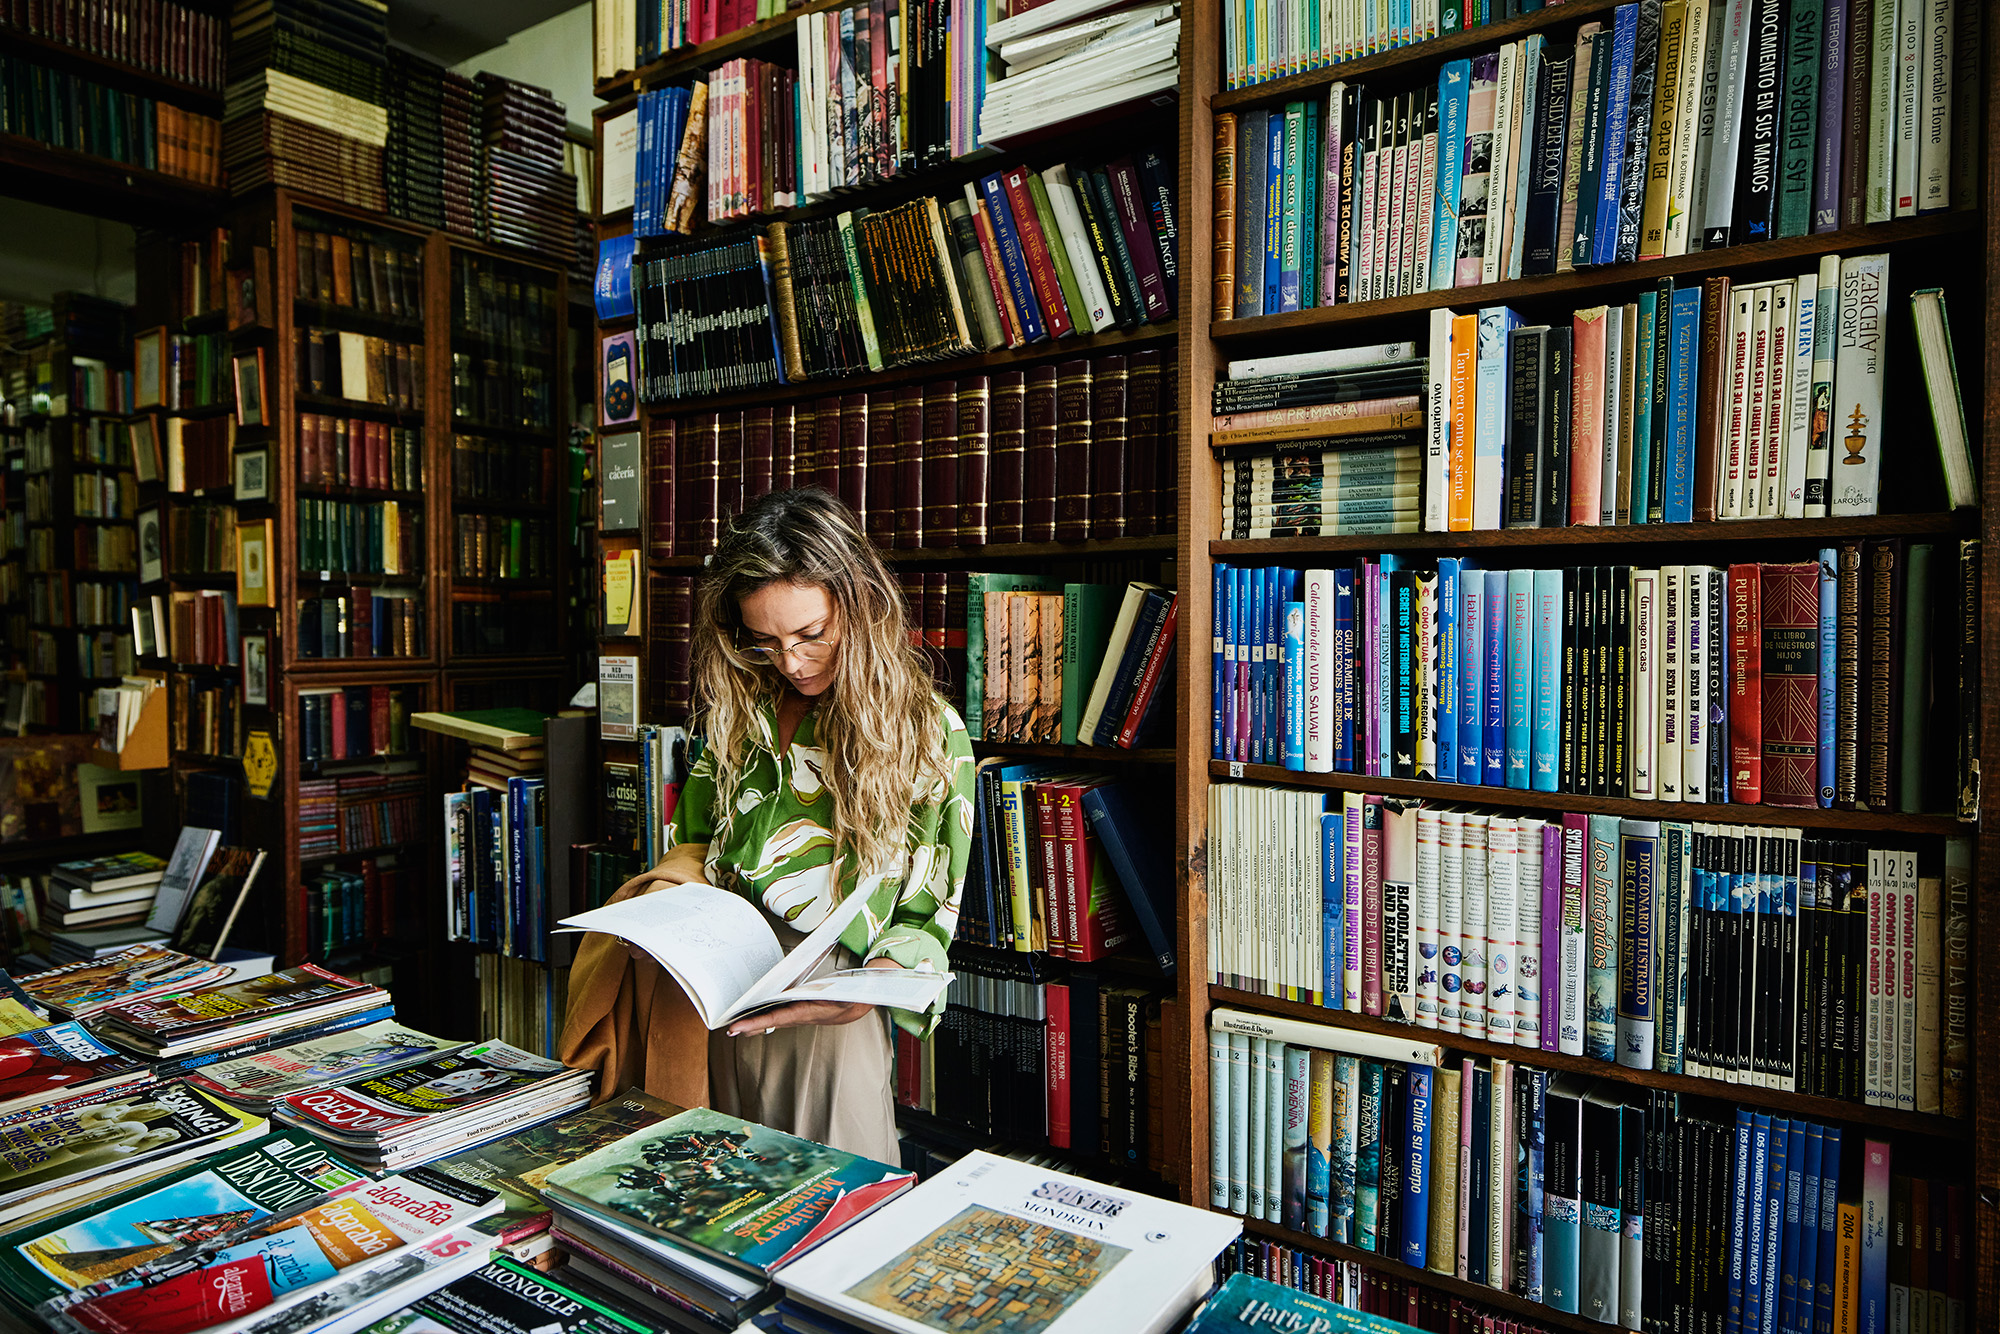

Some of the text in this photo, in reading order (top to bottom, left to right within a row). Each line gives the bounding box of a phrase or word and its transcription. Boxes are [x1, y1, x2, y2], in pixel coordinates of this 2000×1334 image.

[1905, 19, 1916, 49] color
[1931, 26, 1948, 102] Comfortable
[1428, 102, 1438, 118] 5
[1653, 19, 1681, 181] El arte vietnamita
[1757, 92, 1773, 111] EN
[1786, 10, 1816, 193] LAS PIEDRAS VIVAS
[1902, 65, 1915, 140] minimalismo
[1368, 125, 1373, 139] 1
[1384, 120, 1392, 135] 2
[1398, 118, 1407, 134] 3
[1413, 112, 1422, 128] 4
[1543, 60, 1569, 189] THE SILVER BOOK
[1756, 114, 1772, 139] SUS
[1931, 106, 1945, 144] Home
[1287, 110, 1300, 170] Jóvenes,
[1627, 116, 1644, 212] Arte Iberoamericano
[1752, 144, 1769, 193] MANOS
[1288, 176, 1296, 205] sexo
[1339, 142, 1353, 277] EL MUNDO DE LA CIENCIA
[1159, 186, 1175, 238] diccionario
[1362, 154, 1374, 276] GRANDES BIOGRAFIAS
[1285, 222, 1296, 266] drogas
[1091, 223, 1120, 307] méxico desconocido
[1740, 303, 1746, 314] 1
[1759, 300, 1767, 312] 2
[1777, 297, 1785, 309] 3
[1843, 271, 1859, 348] LAROUSSE
[1736, 331, 1746, 369] PADRES
[1793, 298, 1813, 432] BAYERN BAVIERA
[1867, 356, 1876, 374] DEL
[1734, 389, 1743, 404] DE
[1735, 371, 1744, 387] LOS
[1430, 383, 1442, 456] El acuario vivo
[1454, 349, 1469, 500] Tan joven como se siente
[1730, 437, 1739, 464] GRAN
[609, 466, 634, 480] cacería
[1729, 467, 1738, 479] EL
[1421, 606, 1429, 663] CÓMO ACTUAR
[1639, 613, 1649, 636] mago
[1640, 638, 1647, 649] en
[1711, 578, 1720, 697] SOBRENATURAL
[1735, 578, 1748, 696] PURPOSE in Literature
[1310, 582, 1320, 742] Calendario de la VIDA SALVAJE
[1765, 641, 1775, 649] DE
[1335, 630, 1343, 750] SOLUCIONES INGENIOSAS
[1345, 660, 1353, 706] FAMILIAR
[1345, 708, 1352, 720] DE
[1421, 688, 1430, 740] EMERGENCIA
[607, 782, 637, 801] La crisis
[1003, 791, 1017, 811] 15
[1011, 813, 1019, 843] minutos
[1014, 847, 1019, 855] al
[1874, 859, 1878, 876] 1
[1888, 859, 1895, 876] 2
[1906, 861, 1913, 878] 3
[1346, 807, 1360, 972] AUXILIO PARA CASOS IMPREVISTOS
[1365, 834, 1380, 983] LOS PORQUÉS DE LA BIBLIA
[1590, 837, 1614, 970] Los Intrépidos
[1384, 884, 1396, 973] AND BADMEN
[1397, 884, 1409, 993] BLOODLETTERS
[1623, 860, 1636, 994] DE CULTURA ESENCIAL
[1637, 852, 1650, 1006] DICCIONARIO ILUSTRADO
[1870, 892, 1880, 995] CUERPO HUMANO
[1128, 1003, 1138, 1082] Shooter's Bible
[28, 1120, 66, 1146] de los
[52, 1112, 85, 1135] Libro
[466, 1112, 530, 1138] Food Processor Cook Book
[1360, 1093, 1371, 1148] FEMENINA
[1740, 1128, 1748, 1146] LOS
[2, 1127, 51, 1164] muertos
[1411, 1099, 1426, 1194] Cuide su cuerpo
[1737, 1148, 1748, 1197] MOVIMIENTOS
[734, 1177, 845, 1237] Miniatures
[1022, 1201, 1108, 1230] MONDRIAN
[1735, 1199, 1745, 1236] ARMADOS
[1734, 1237, 1743, 1249] EN
[1843, 1213, 1854, 1240] 2004
[478, 1264, 582, 1316] MONOCLE
